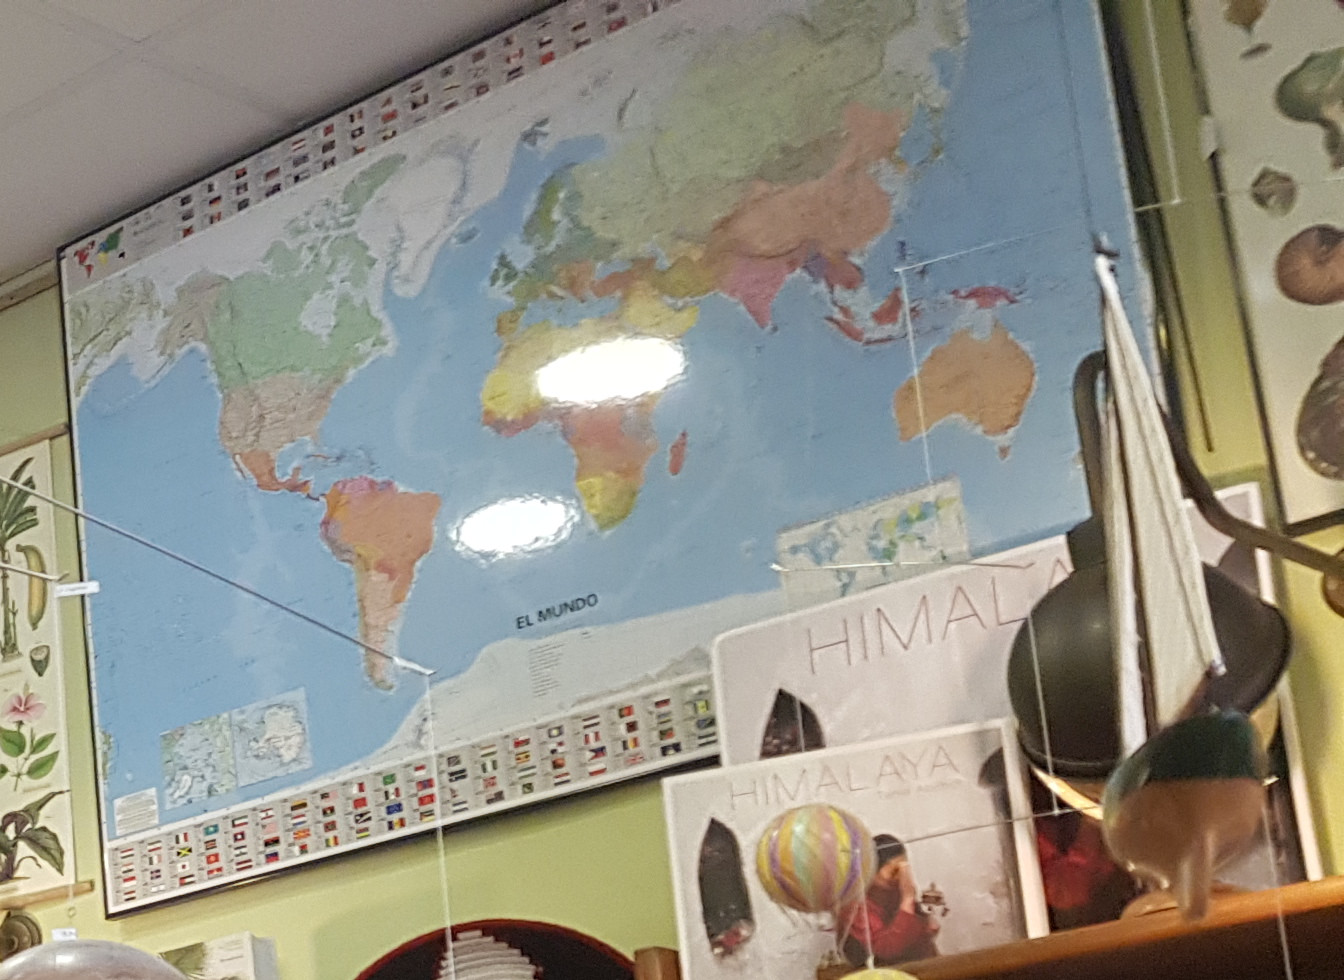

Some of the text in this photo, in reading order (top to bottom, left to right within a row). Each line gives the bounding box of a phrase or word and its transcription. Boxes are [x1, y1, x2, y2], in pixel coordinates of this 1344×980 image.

[516, 593, 599, 629] EL MUNDO
[730, 746, 960, 810] HIMALAYA
